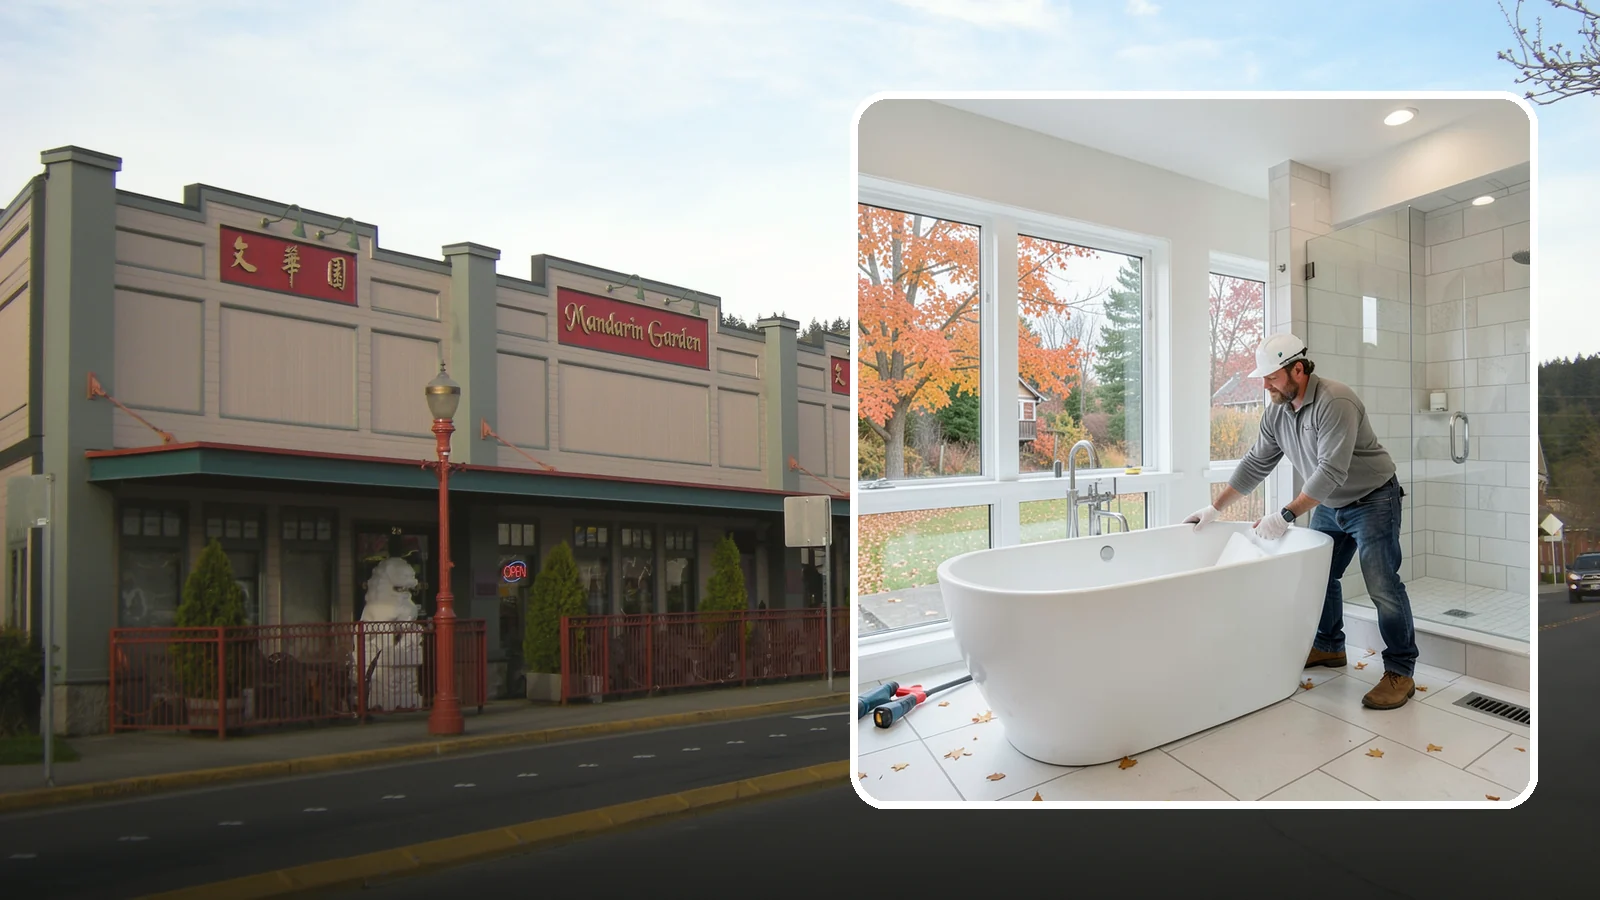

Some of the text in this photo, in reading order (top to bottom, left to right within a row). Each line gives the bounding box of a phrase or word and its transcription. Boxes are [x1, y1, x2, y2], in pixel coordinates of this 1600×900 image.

[230, 235, 346, 291] 文華園
[564, 302, 701, 352] Mandarin Garden
[834, 362, 846, 387] 文
[503, 565, 527, 578] OPEN
